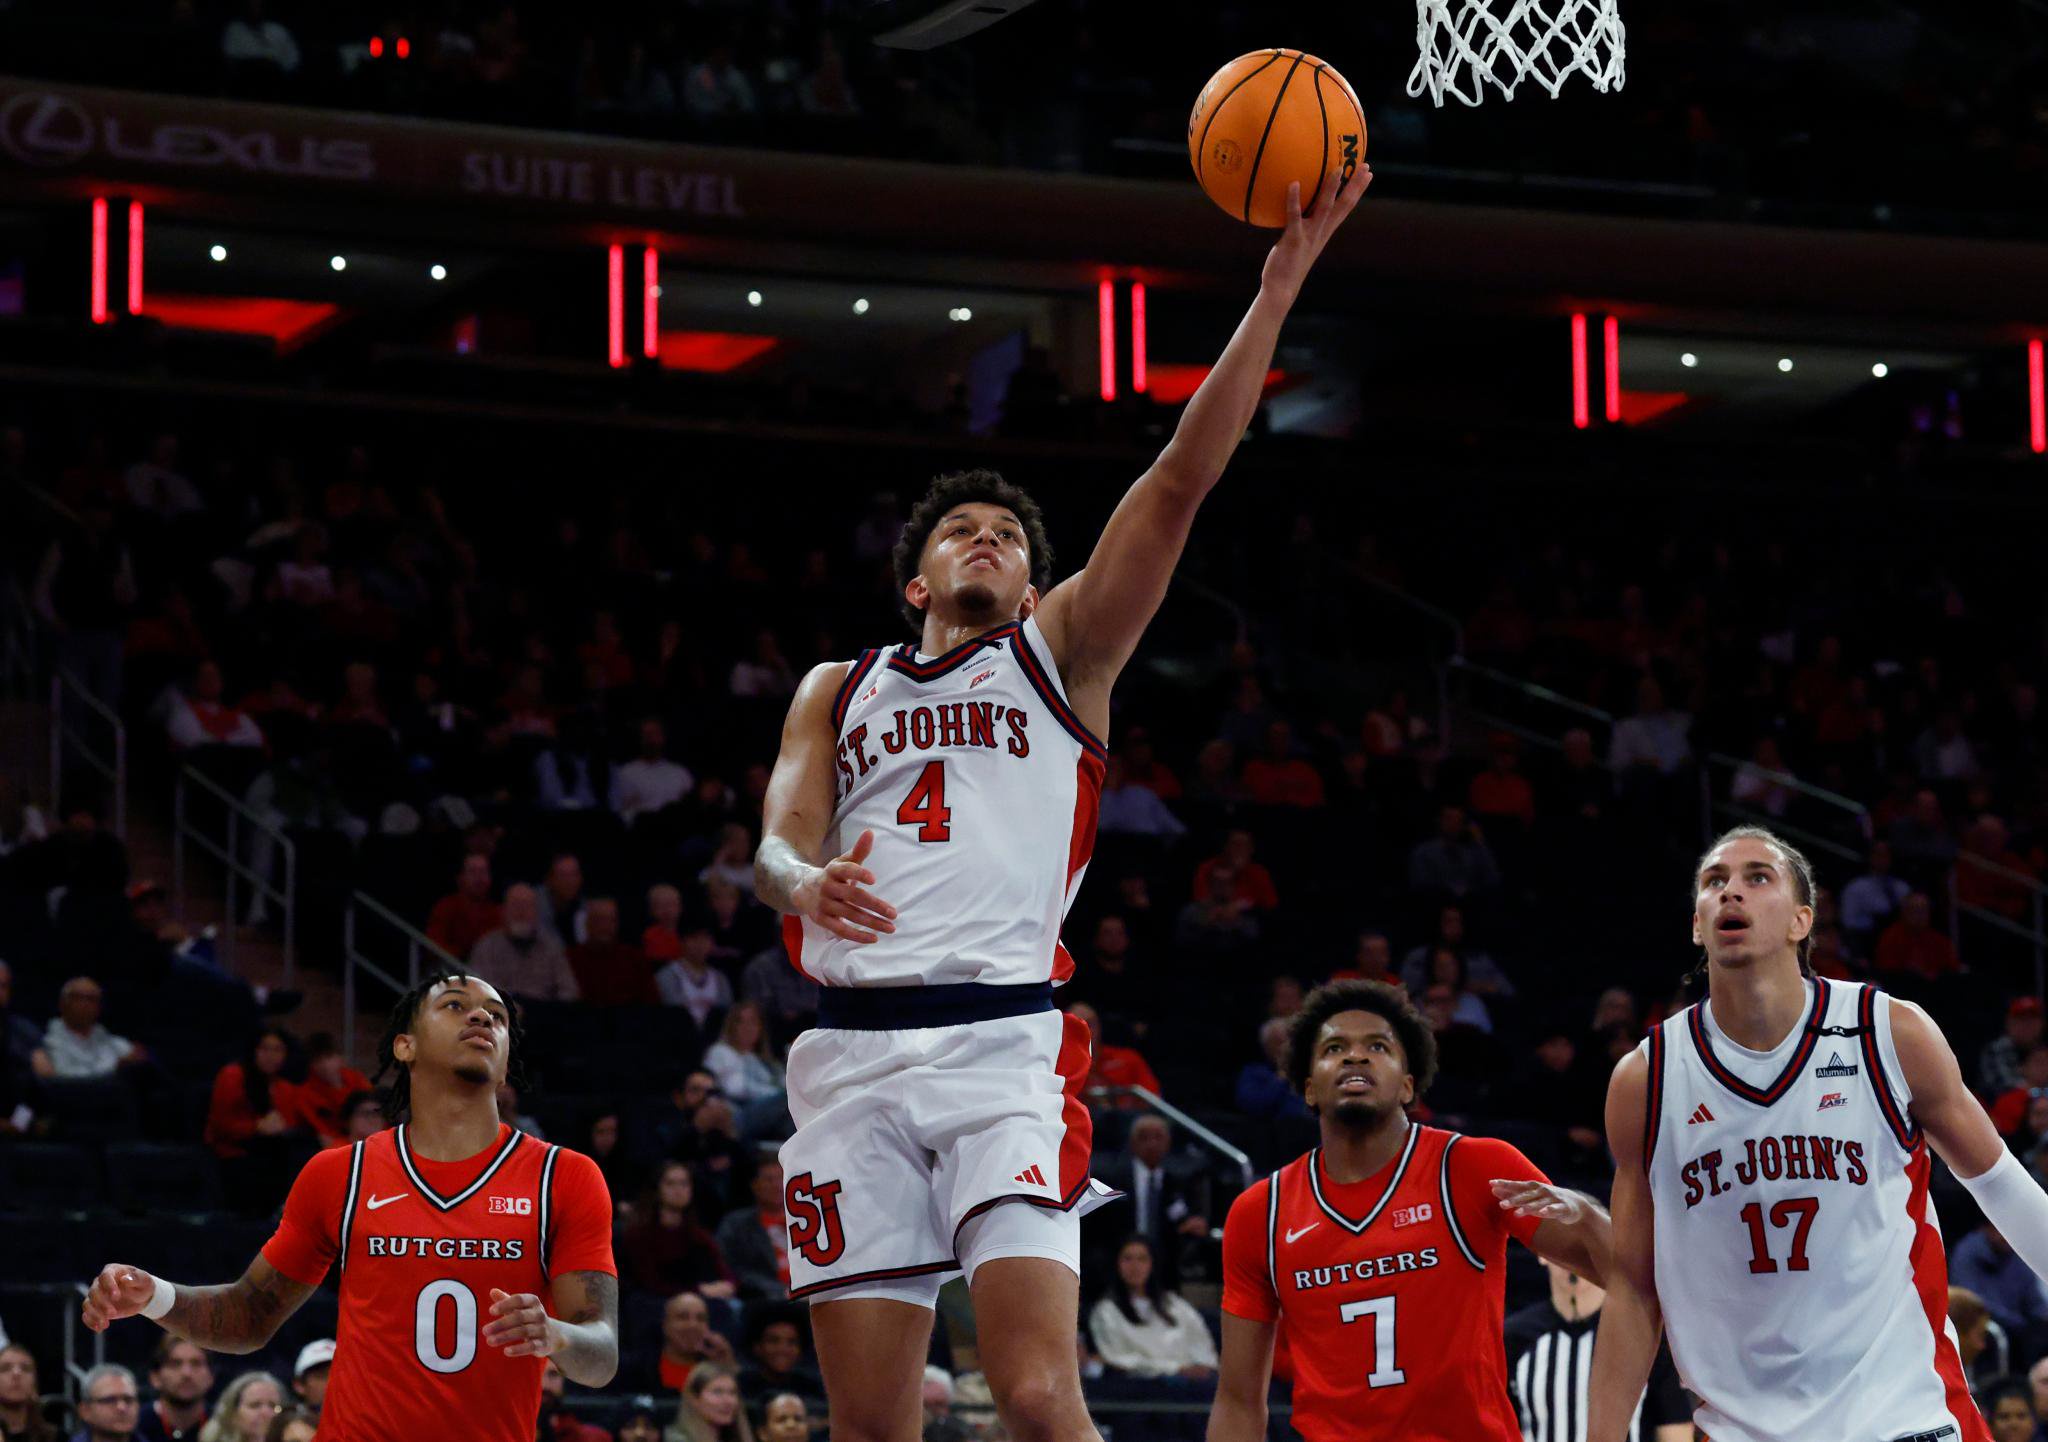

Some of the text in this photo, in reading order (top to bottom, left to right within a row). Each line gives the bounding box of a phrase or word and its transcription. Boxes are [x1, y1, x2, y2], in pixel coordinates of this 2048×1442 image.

[103, 116, 377, 181] LEXUS
[461, 152, 745, 220] SUITE LEVEL
[836, 702, 1030, 799] ST. JOHN'S
[897, 760, 951, 842] 4
[1681, 1135, 1868, 1210] ST. JOHN'S
[368, 1237, 523, 1259] RUTGERS
[1294, 1248, 1440, 1290] RUTGERS
[1740, 1197, 1820, 1274] 17
[415, 1278, 478, 1374] 0
[1340, 1296, 1406, 1388] 7
